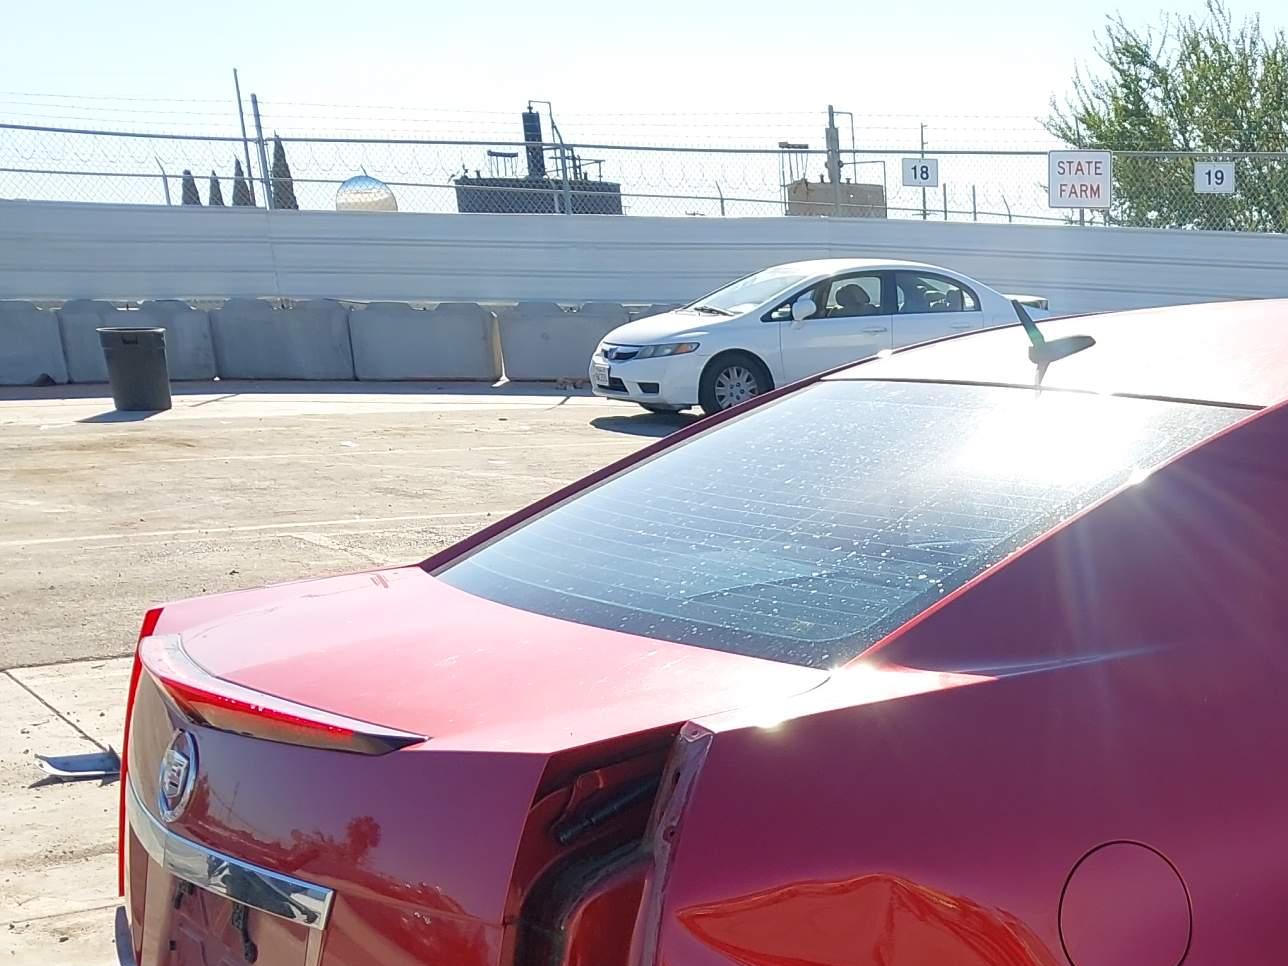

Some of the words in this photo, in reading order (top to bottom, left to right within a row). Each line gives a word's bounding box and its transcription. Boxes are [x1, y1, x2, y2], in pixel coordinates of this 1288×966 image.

[911, 164, 930, 181] 18
[1057, 160, 1103, 176] STATE
[1204, 169, 1225, 186] 19
[1059, 184, 1101, 199] FARM
